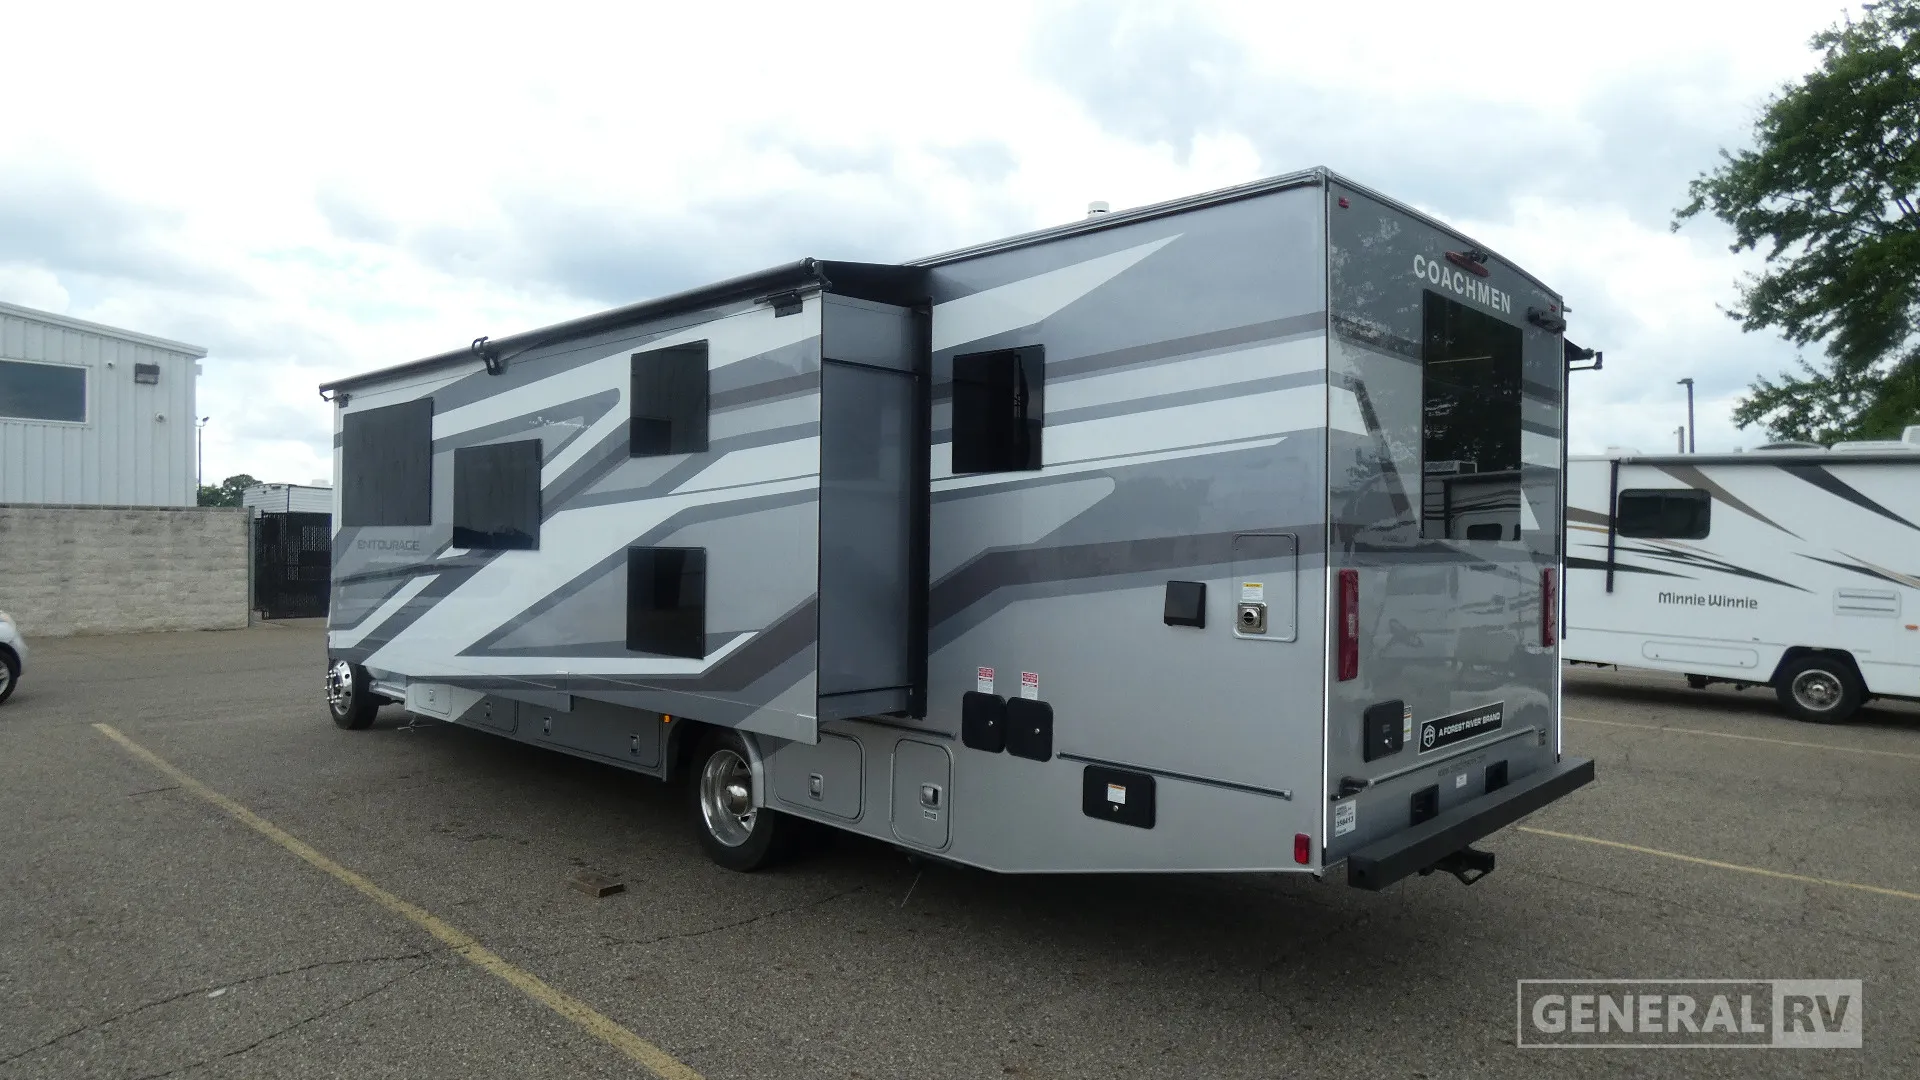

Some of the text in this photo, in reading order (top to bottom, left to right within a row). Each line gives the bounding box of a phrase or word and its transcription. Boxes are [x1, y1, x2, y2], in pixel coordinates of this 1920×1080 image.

[1414, 255, 1511, 314] COACHMEN
[357, 540, 420, 551] ENTOURAGE
[1658, 591, 1758, 609] Minnie Winnie
[1438, 712, 1501, 737] A FOREST RIVER BRAND
